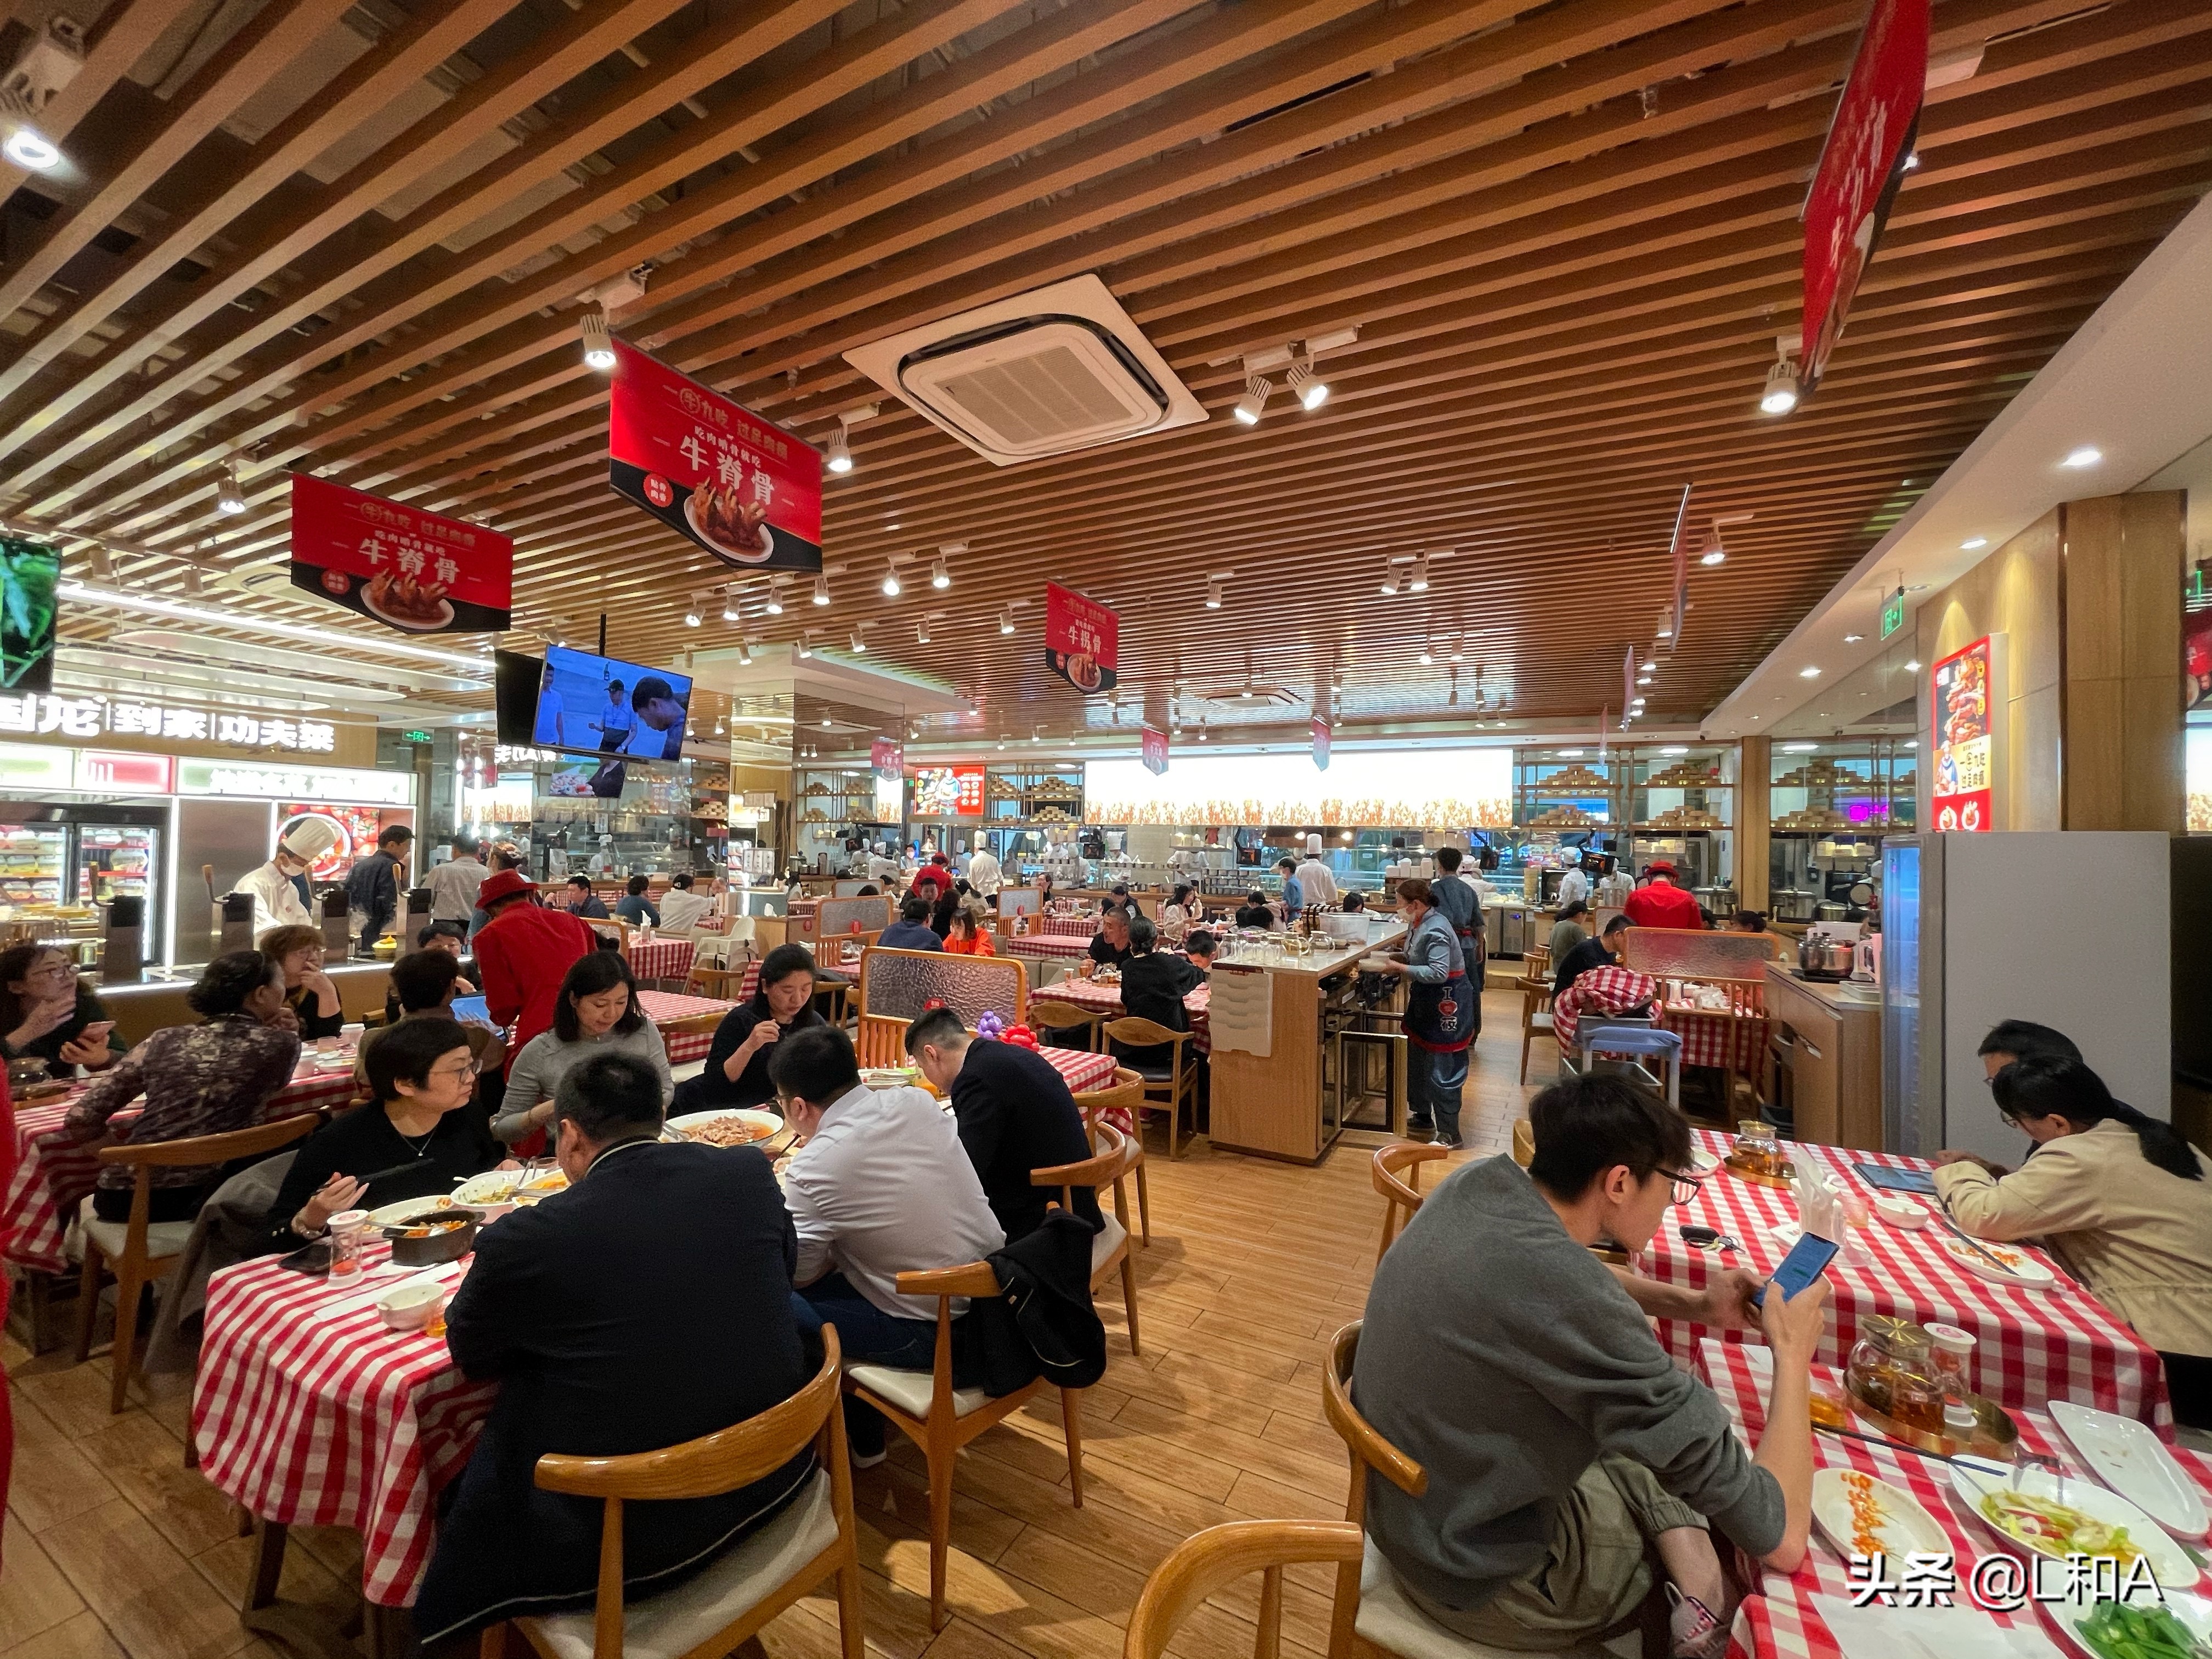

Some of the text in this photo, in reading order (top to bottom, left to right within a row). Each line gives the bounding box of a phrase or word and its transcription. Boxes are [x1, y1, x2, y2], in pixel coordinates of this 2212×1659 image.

[679, 435, 776, 505] 牛脊骨
[358, 538, 460, 584] 牛脊骨
[113, 701, 207, 739] 到家
[218, 715, 335, 752] 功夫菜
[1442, 986, 1453, 1001] I
